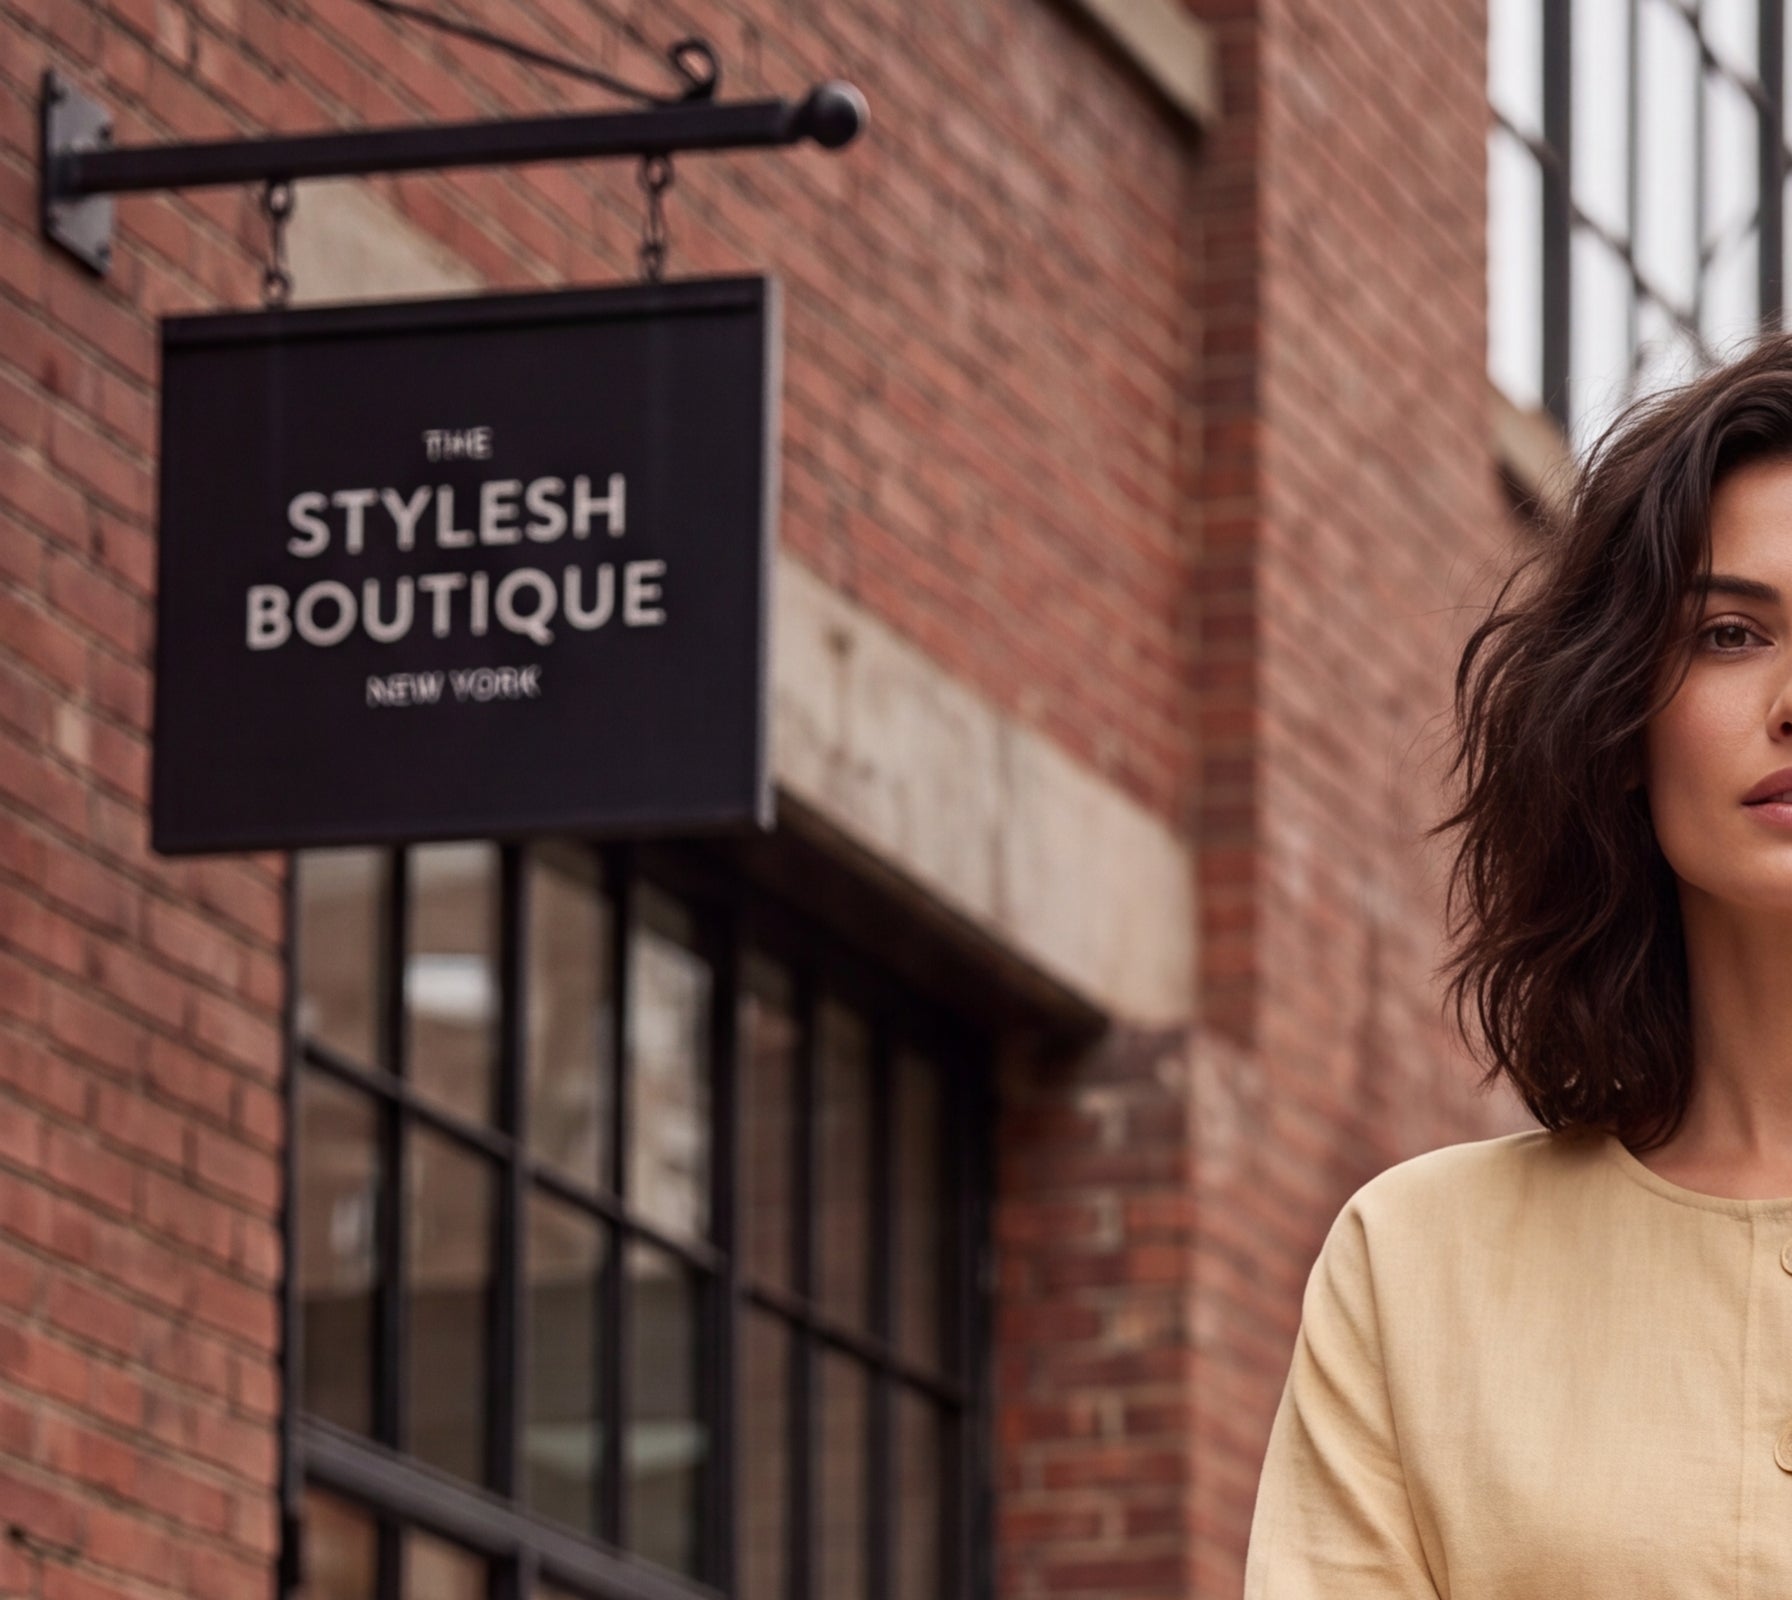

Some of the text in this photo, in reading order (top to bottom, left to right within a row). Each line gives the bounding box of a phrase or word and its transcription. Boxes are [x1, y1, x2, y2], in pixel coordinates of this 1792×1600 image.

[425, 428, 491, 460] THE
[287, 472, 625, 557] STYLESH
[245, 560, 666, 651] BOUTIQUE
[367, 665, 541, 706] NEW YORK
